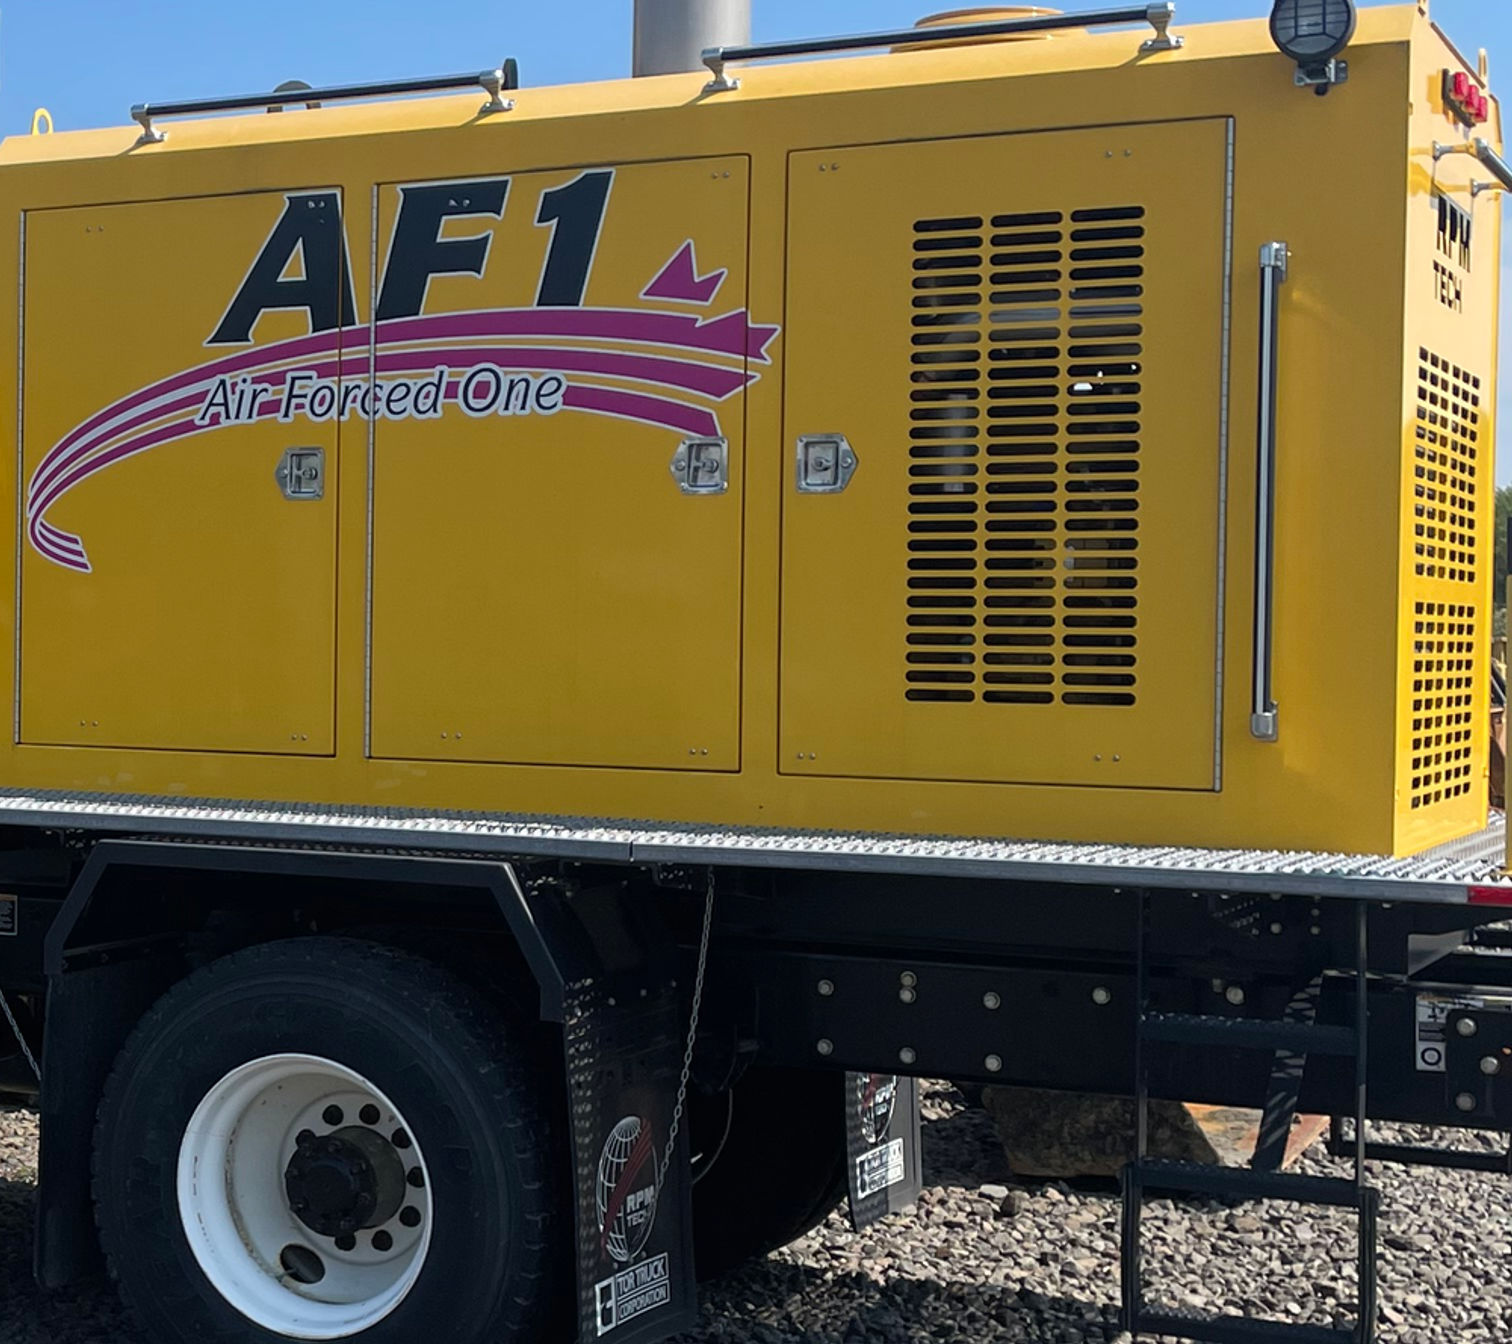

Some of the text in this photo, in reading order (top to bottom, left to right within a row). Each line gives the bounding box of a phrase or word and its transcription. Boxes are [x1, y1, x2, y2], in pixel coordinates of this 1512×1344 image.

[204, 169, 615, 345] AF1
[1436, 194, 1471, 274] RPM
[1432, 259, 1463, 315] TECH
[198, 367, 564, 423] Air Forced One
[626, 1184, 655, 1213] RPM
[635, 1257, 665, 1288] TRUCK
[619, 1284, 667, 1319] CORPORATION
